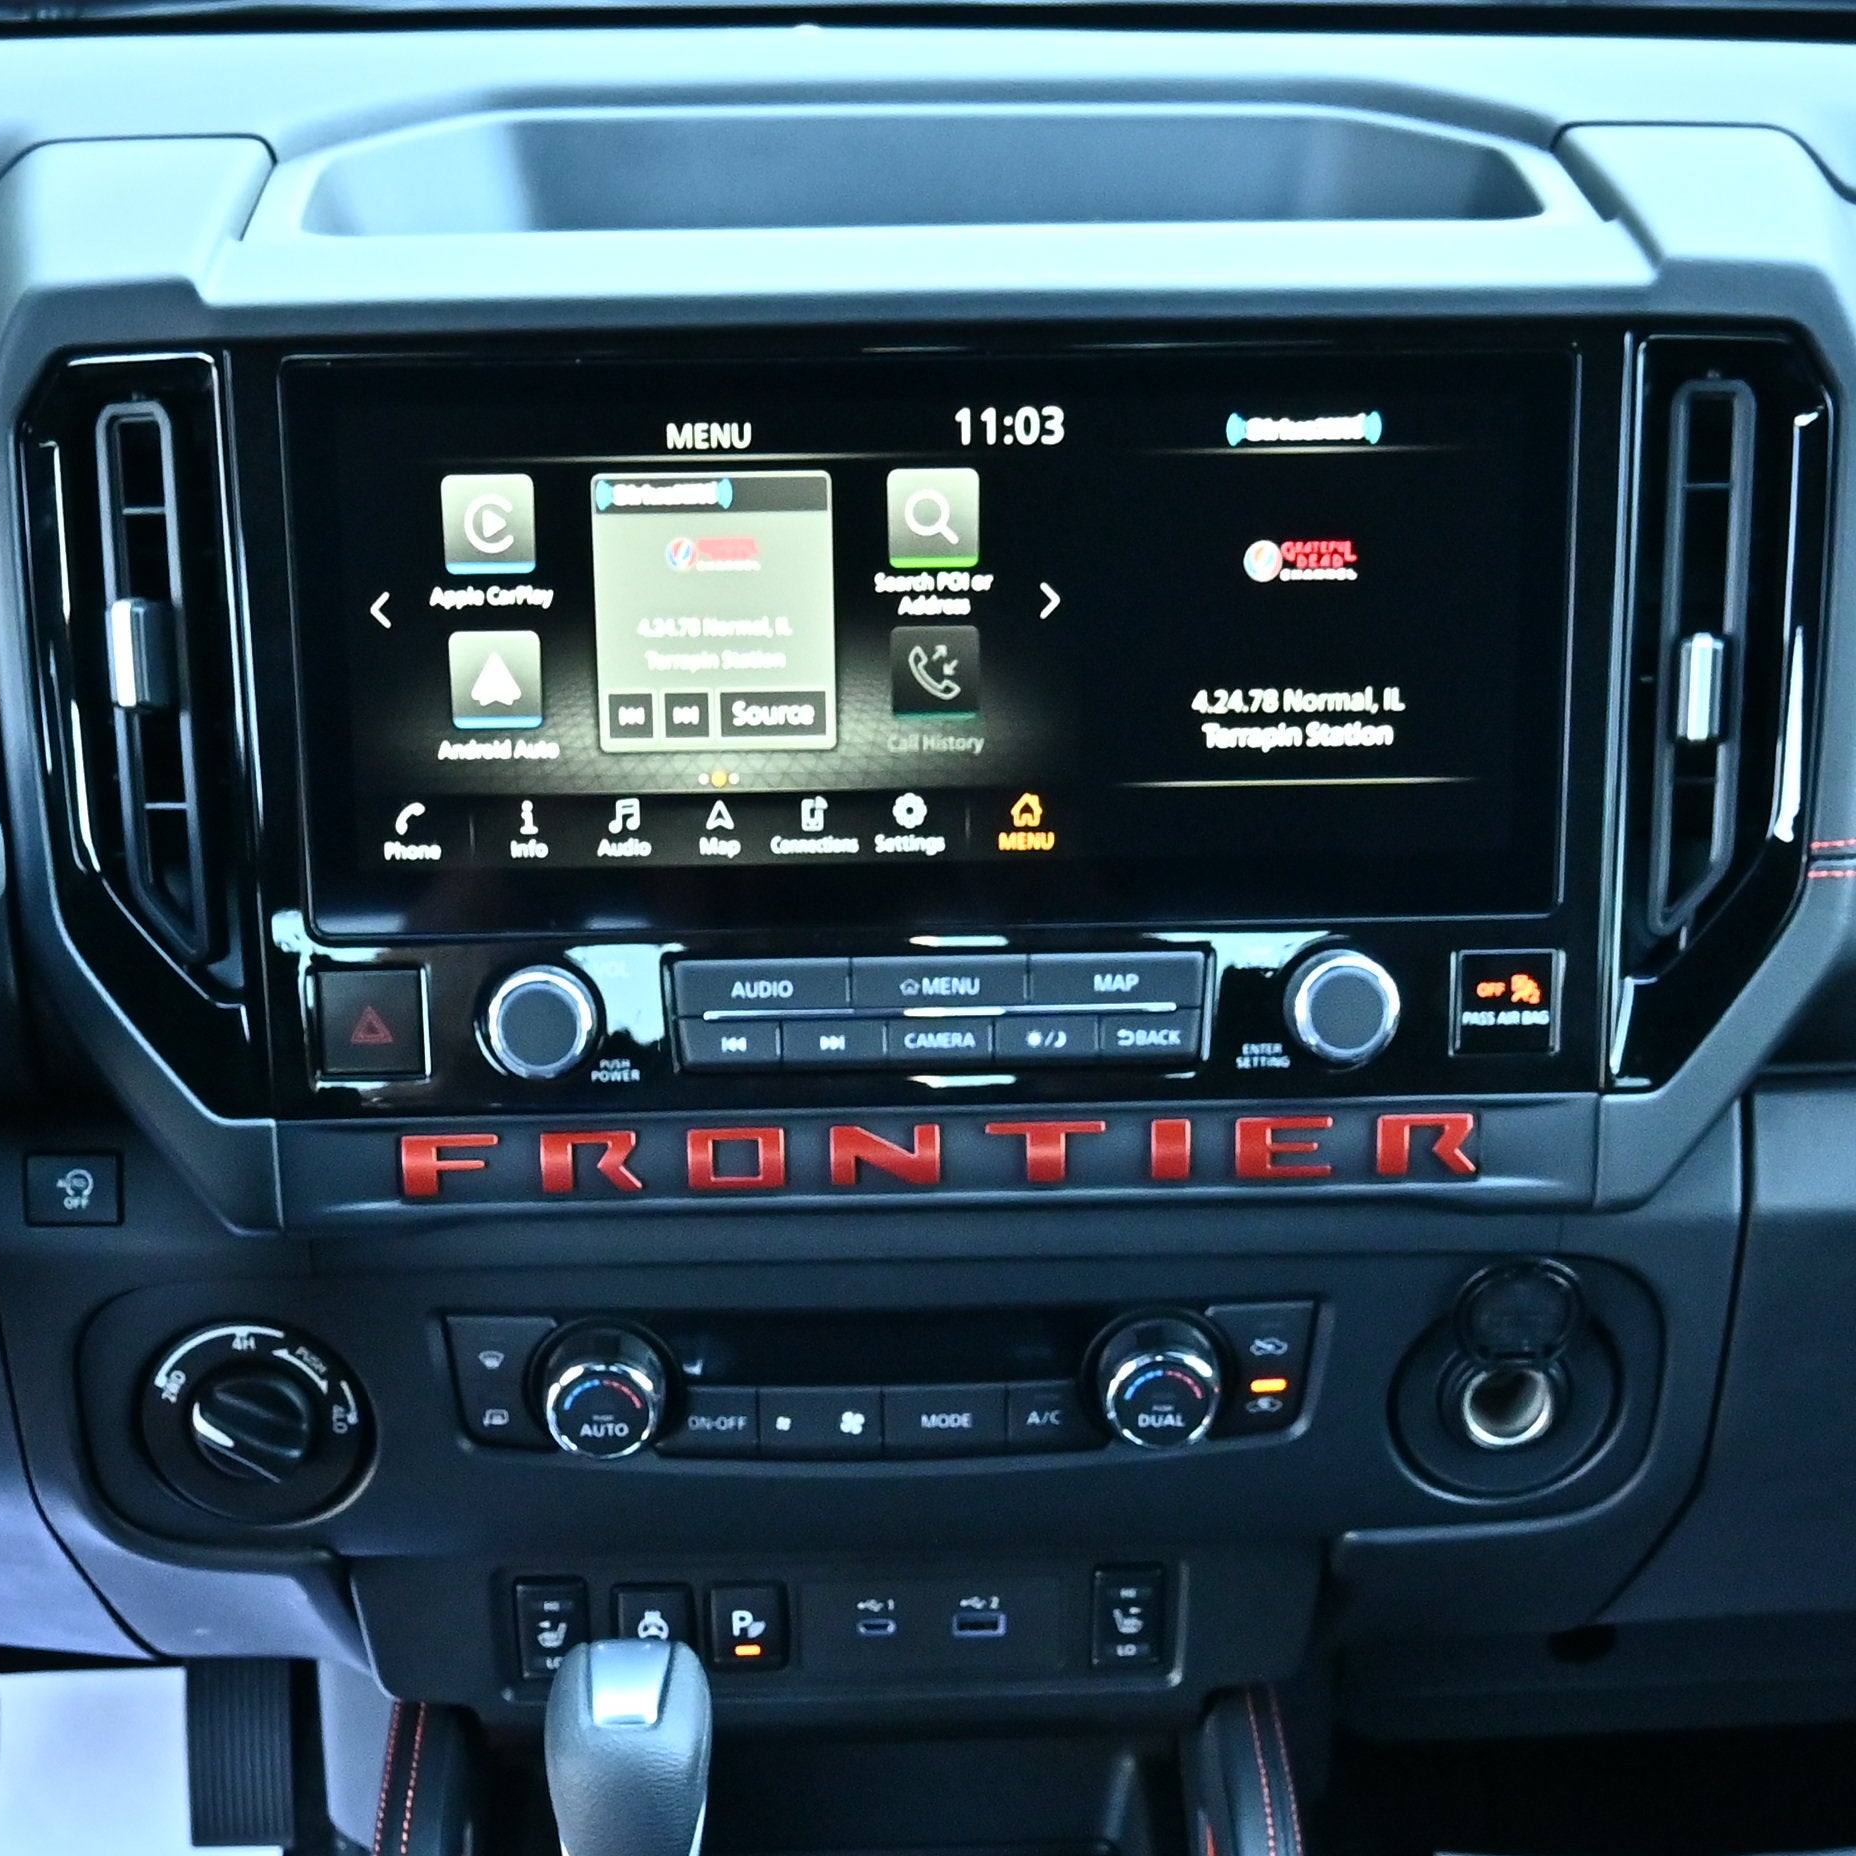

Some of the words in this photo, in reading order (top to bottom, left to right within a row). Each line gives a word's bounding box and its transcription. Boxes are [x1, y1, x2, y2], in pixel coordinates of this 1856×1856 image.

[955, 406, 1065, 445] 11:03
[666, 422, 752, 450] MENU
[874, 571, 935, 593] Search
[936, 571, 970, 592] POI
[971, 574, 994, 592] or
[429, 585, 485, 610] Apple
[486, 585, 554, 610] CarPlay
[1282, 686, 1379, 714] Normal,
[1382, 687, 1407, 712] IL
[732, 700, 815, 727] Source
[887, 734, 920, 752] Call
[922, 734, 985, 756] History
[1201, 722, 1303, 753] Terrapin
[1305, 721, 1394, 748] Station
[438, 739, 512, 760] Android
[513, 739, 560, 760] Auto
[384, 840, 442, 860] Phone
[510, 838, 549, 858] Info
[597, 838, 652, 857] Audio
[699, 836, 741, 858] Map
[770, 835, 860, 854] Connections
[874, 833, 946, 856] Settings
[998, 831, 1055, 851] MENU
[730, 980, 794, 999] AUDIO
[921, 975, 981, 996] MENU
[1093, 973, 1139, 993] MAP
[1462, 1010, 1496, 1026] PASS
[1496, 1010, 1521, 1025] AIR
[1521, 1010, 1549, 1025] BAG
[904, 1031, 976, 1050] CAMERA
[1135, 1028, 1181, 1048] BACK
[591, 1069, 641, 1083] POWER
[400, 1112, 1478, 1198] FRONTIER
[920, 1413, 972, 1428] MODE
[1026, 1409, 1061, 1426] A/C
[1137, 1413, 1186, 1428] DUAL
[579, 1422, 630, 1438] AUTO
